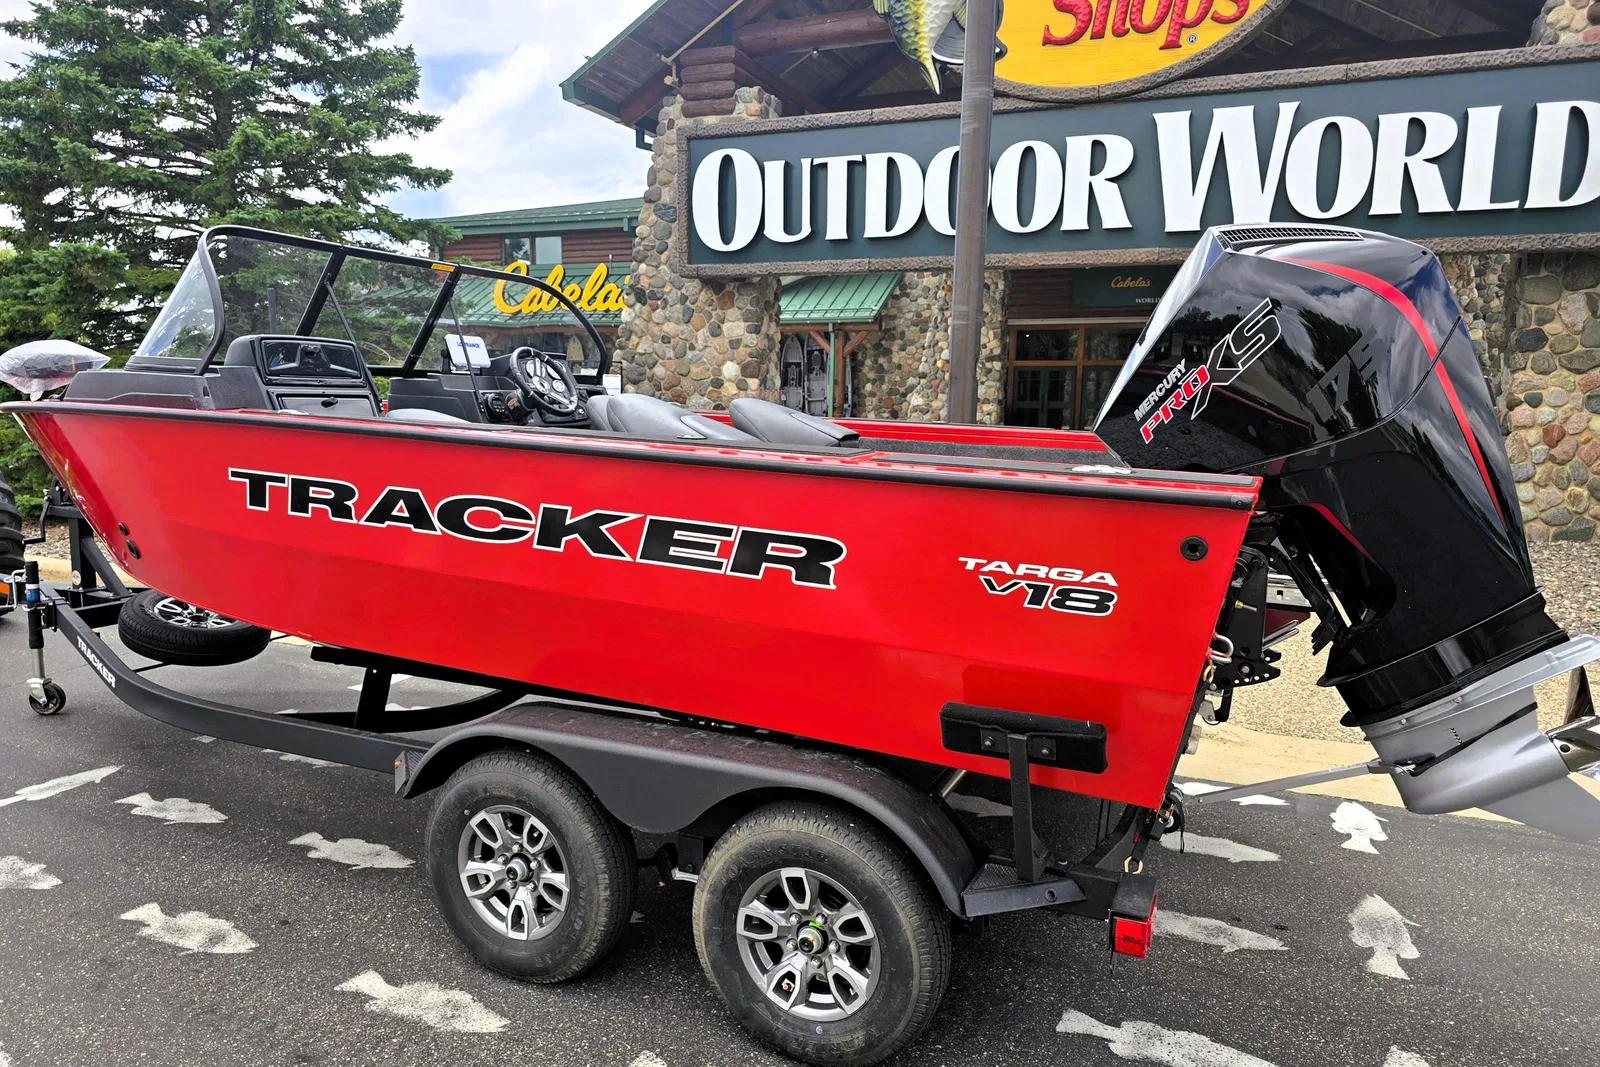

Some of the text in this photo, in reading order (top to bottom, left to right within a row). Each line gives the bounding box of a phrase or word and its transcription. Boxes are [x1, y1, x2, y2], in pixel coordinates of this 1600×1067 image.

[692, 100, 1600, 252] OUTDOOR WORLD
[493, 261, 631, 314] Cabela'
[1133, 358, 1187, 422] MERCURY
[1140, 364, 1210, 444] PRO
[228, 467, 848, 590] TRACKER
[958, 556, 1119, 587] TARGA
[978, 575, 1119, 617] V18
[76, 635, 116, 689] TRACKER
